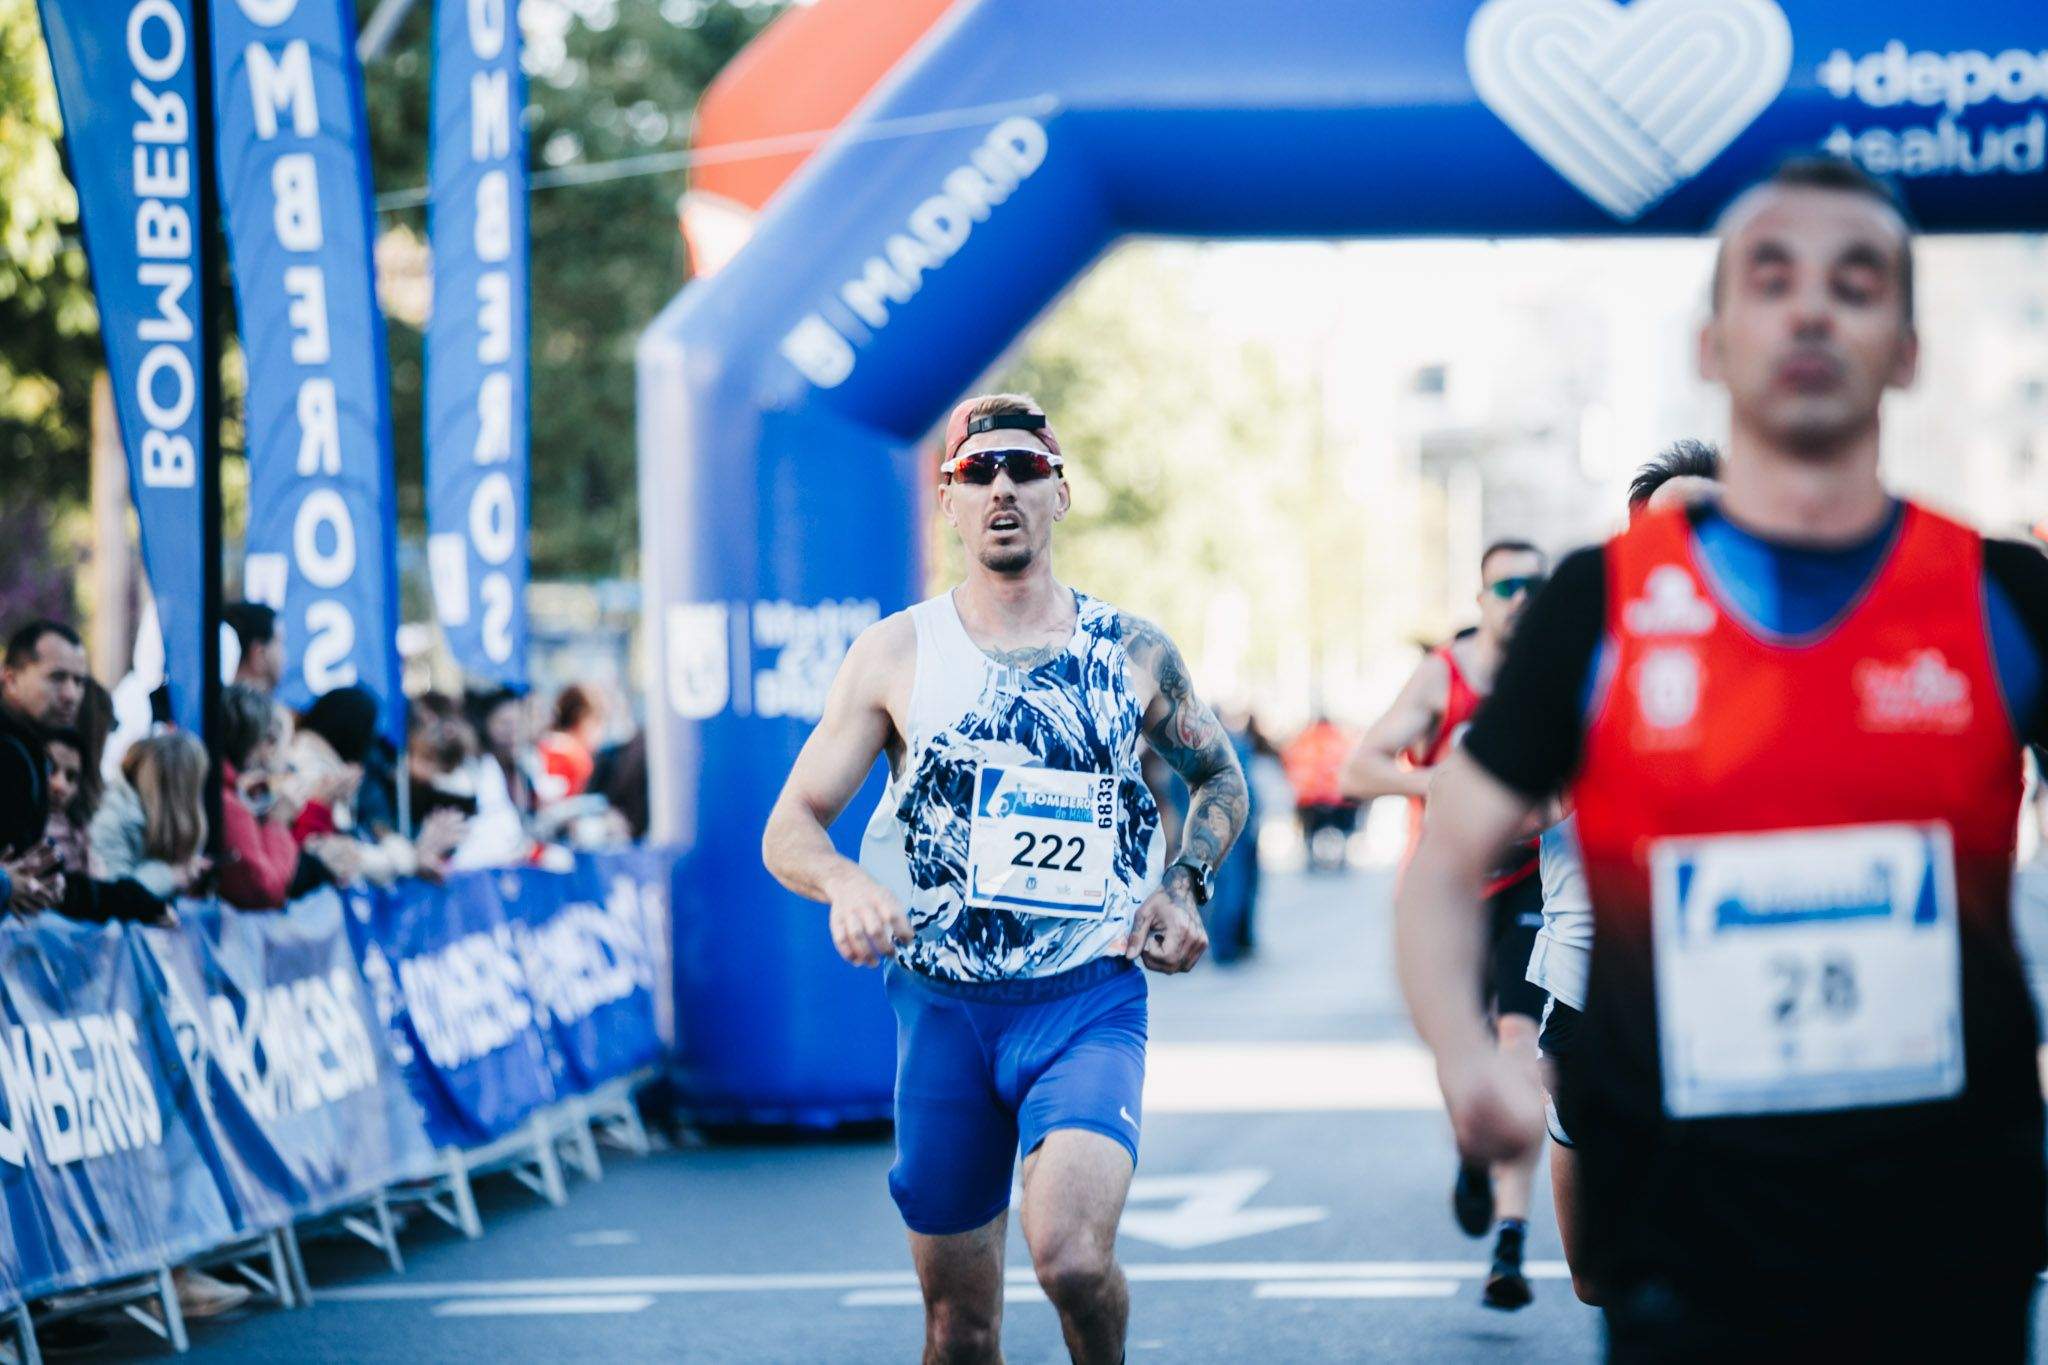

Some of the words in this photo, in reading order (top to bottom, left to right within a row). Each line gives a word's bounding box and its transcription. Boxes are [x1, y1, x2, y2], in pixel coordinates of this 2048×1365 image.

[1816, 38, 2048, 118] +depo
[840, 115, 1048, 329] MADRID
[1097, 777, 1115, 829] 6833
[1011, 831, 1086, 872] 222
